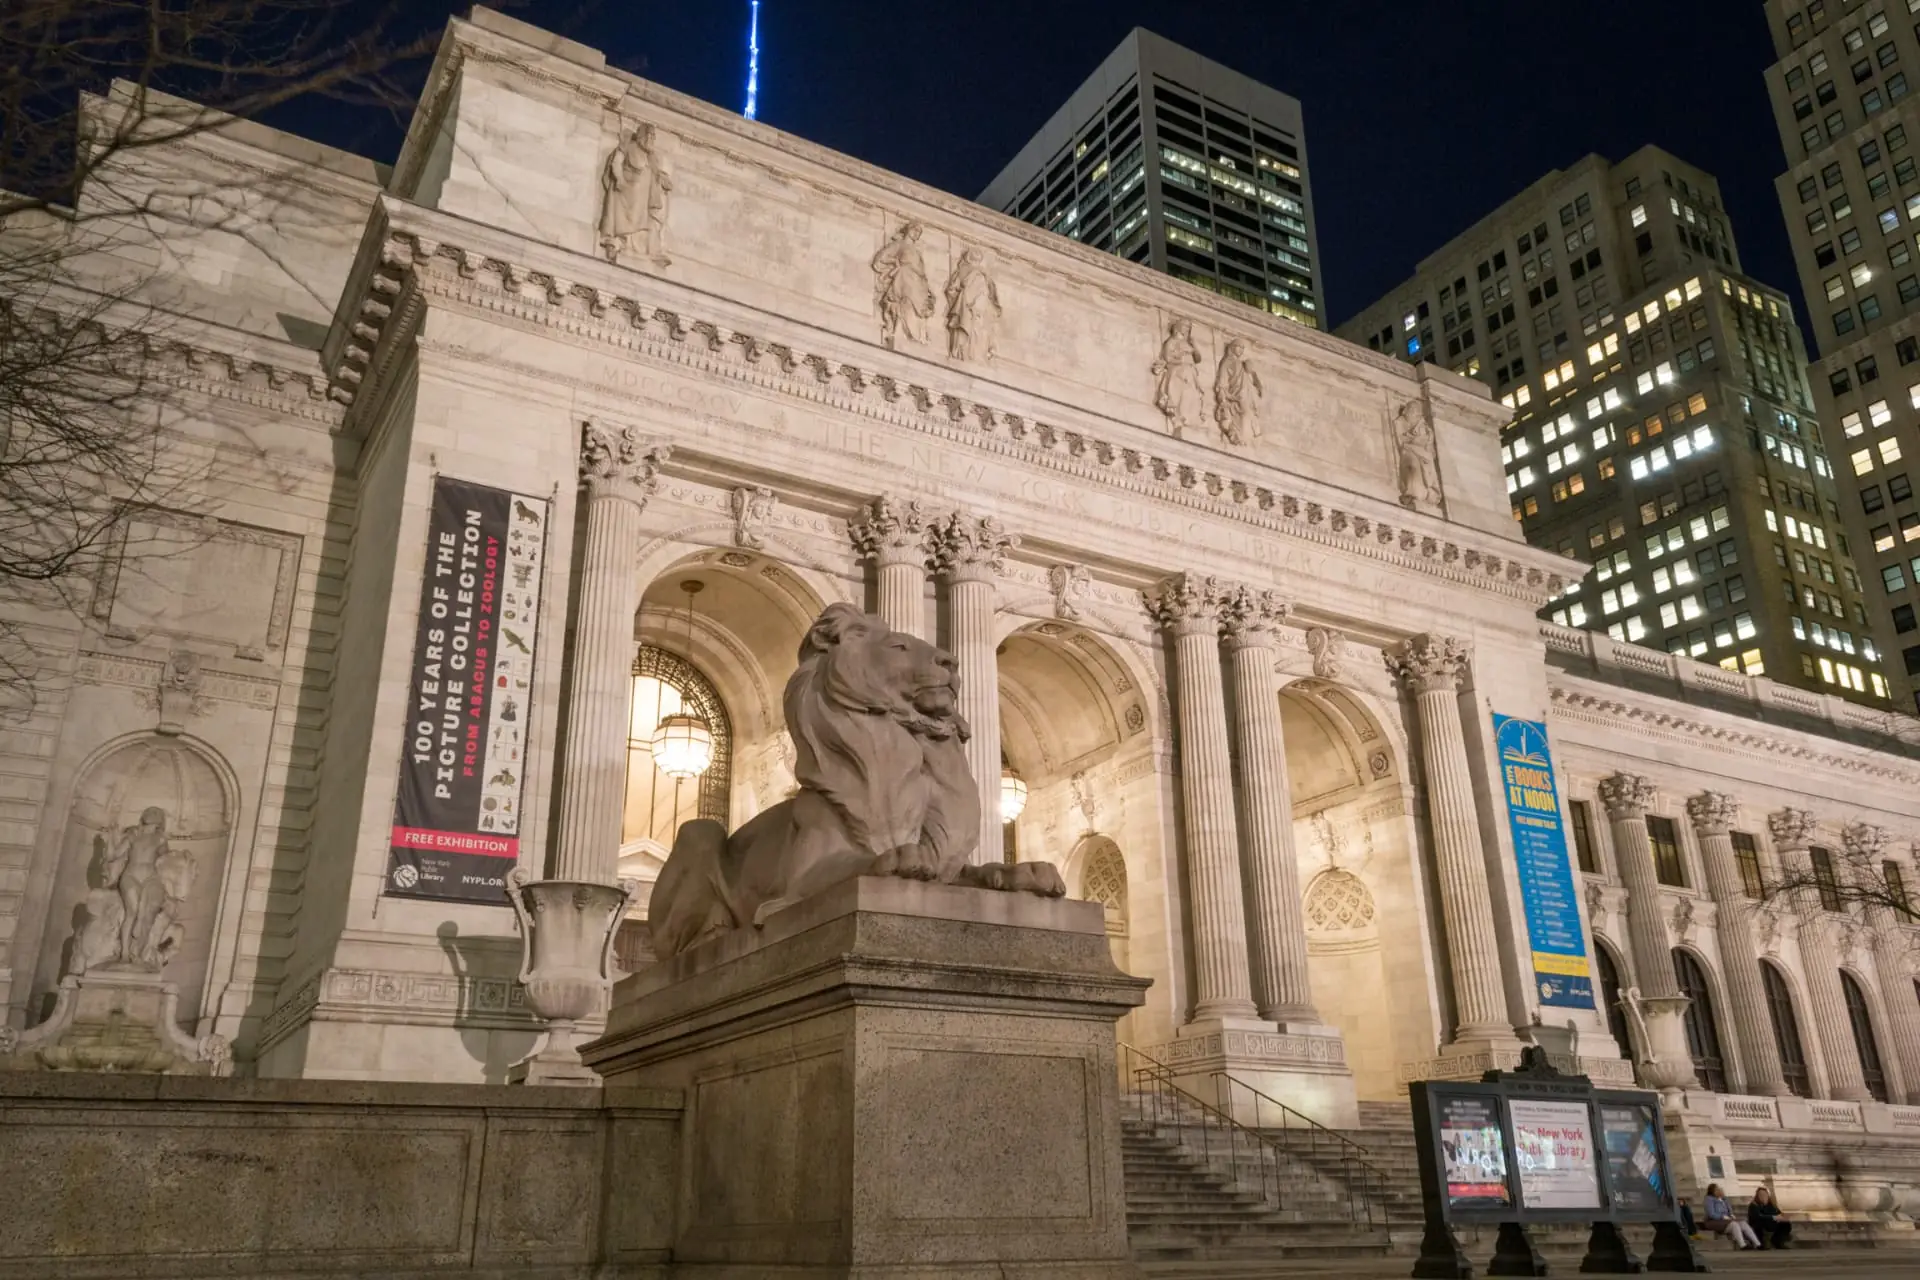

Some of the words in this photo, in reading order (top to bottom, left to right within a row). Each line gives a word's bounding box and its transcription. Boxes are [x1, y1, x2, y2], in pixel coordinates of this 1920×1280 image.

[815, 418, 886, 458] THE
[911, 446, 986, 482] NEW
[1018, 477, 1089, 514] YORK
[1110, 498, 1205, 545] PUBLIC
[1227, 531, 1326, 580] LIBRARY
[435, 531, 456, 577] THE
[480, 536, 500, 614] ZOOLOGY
[431, 586, 449, 619] OF
[477, 619, 490, 640] TO
[420, 628, 445, 711] YEARS
[434, 680, 464, 799] PICTURE
[450, 509, 483, 670] COLLECTION
[469, 647, 488, 718] ABACUS
[414, 721, 434, 764] 100
[463, 723, 480, 777] FROM
[1514, 765, 1552, 791] BOOKS
[1509, 785, 1522, 807] AT
[1523, 788, 1557, 813] NOON
[404, 832, 433, 844] FREE
[437, 835, 508, 852] EXHIBITION
[420, 873, 445, 882] Library
[462, 875, 505, 887] NYPL.OR
[1537, 1127, 1560, 1140] New
[1561, 1128, 1584, 1141] York
